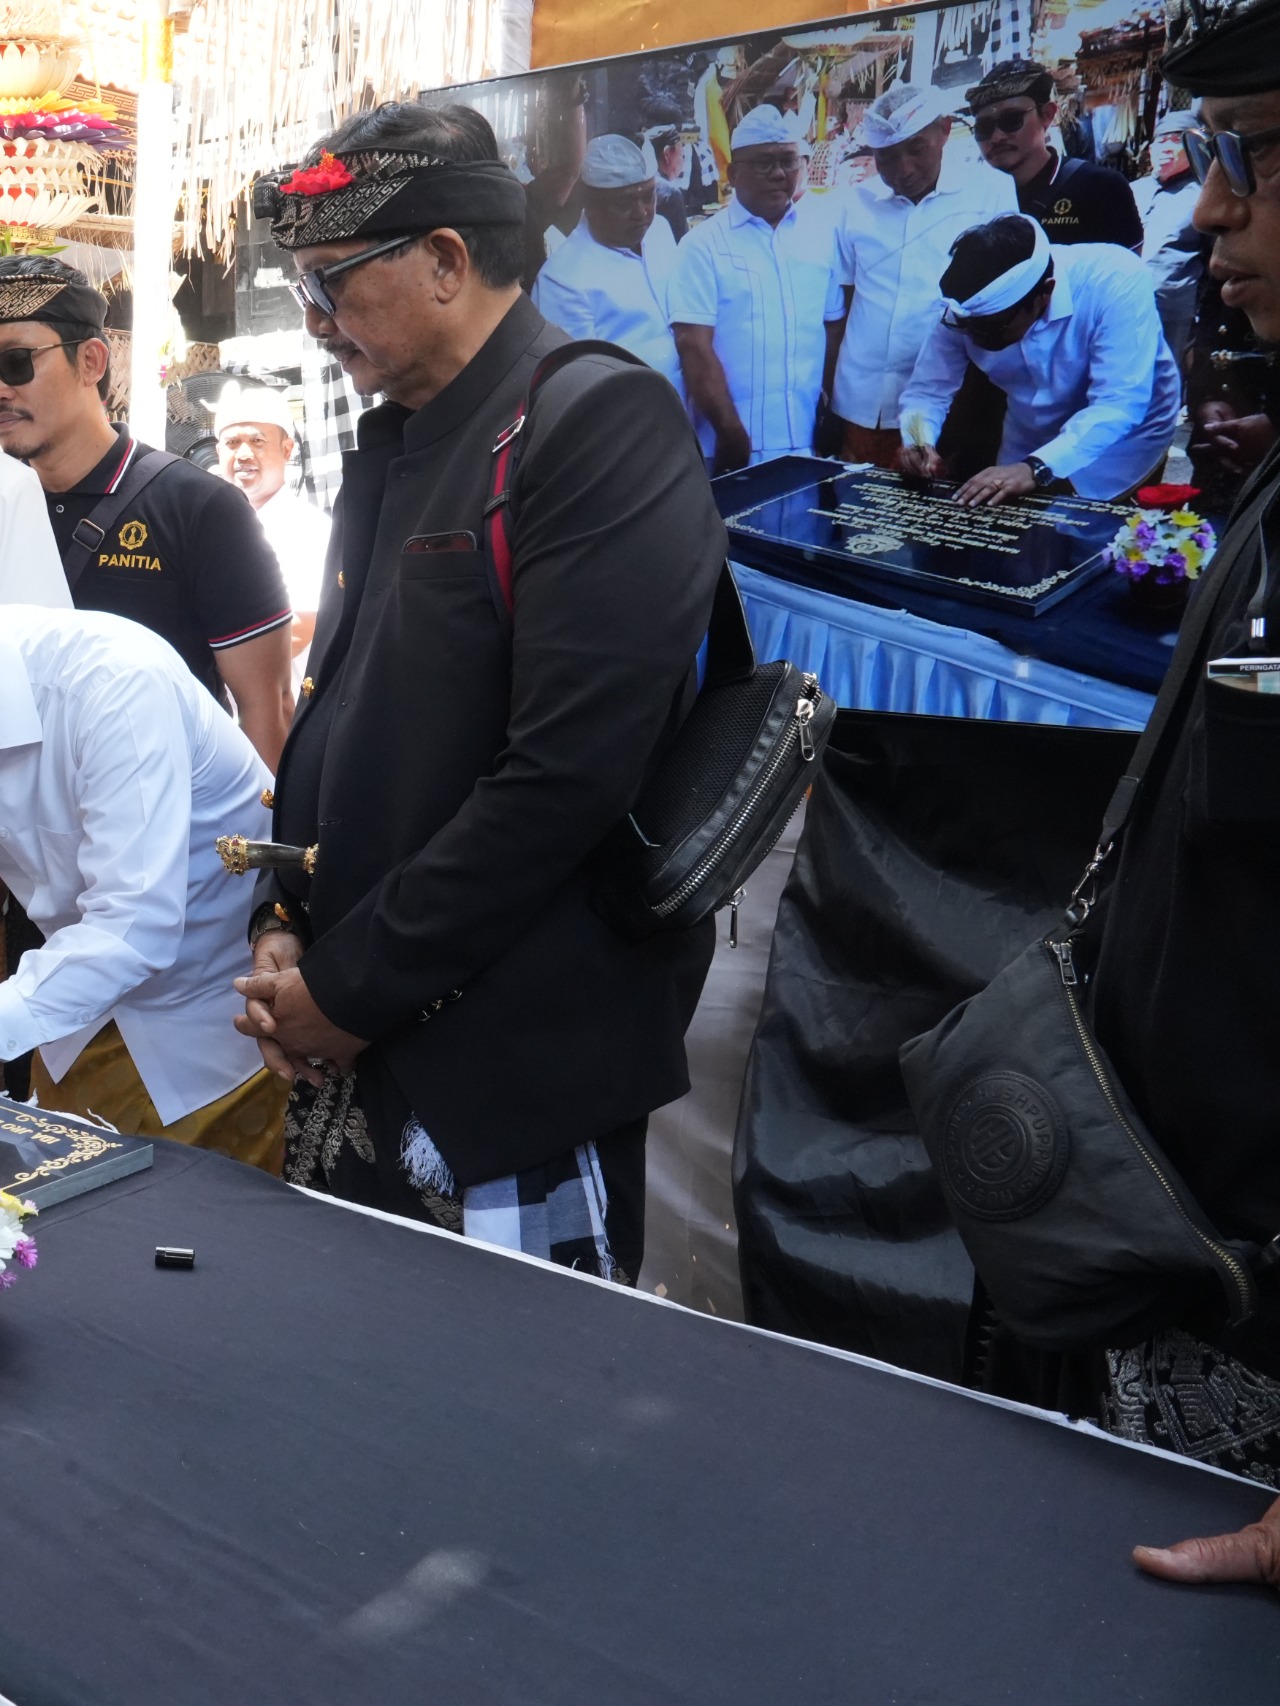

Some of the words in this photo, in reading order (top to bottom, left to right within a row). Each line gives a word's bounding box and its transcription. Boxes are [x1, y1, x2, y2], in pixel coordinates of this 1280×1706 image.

[1041, 216, 1080, 225] PANITIA
[98, 553, 162, 571] PANITIA
[25, 1132, 62, 1144] IDA
